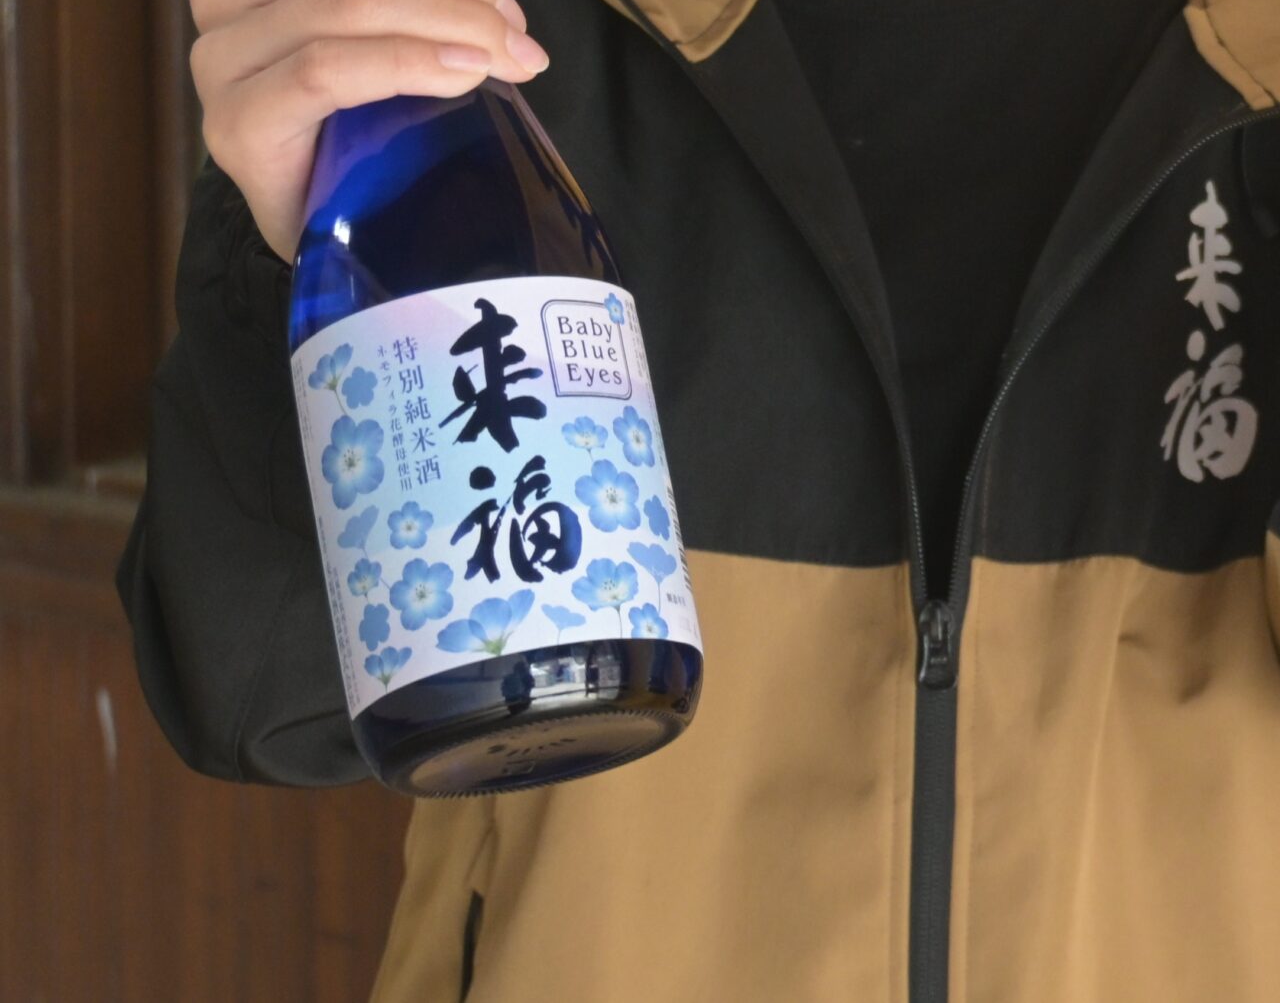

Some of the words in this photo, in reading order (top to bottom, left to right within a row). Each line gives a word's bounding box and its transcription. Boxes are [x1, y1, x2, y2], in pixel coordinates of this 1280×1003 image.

[557, 316, 612, 343] Baby
[562, 339, 618, 362] Blue
[1160, 179, 1258, 483] 来福
[392, 336, 443, 486] 特別純米酒
[566, 363, 623, 387] Eyes
[438, 298, 583, 584] 来福
